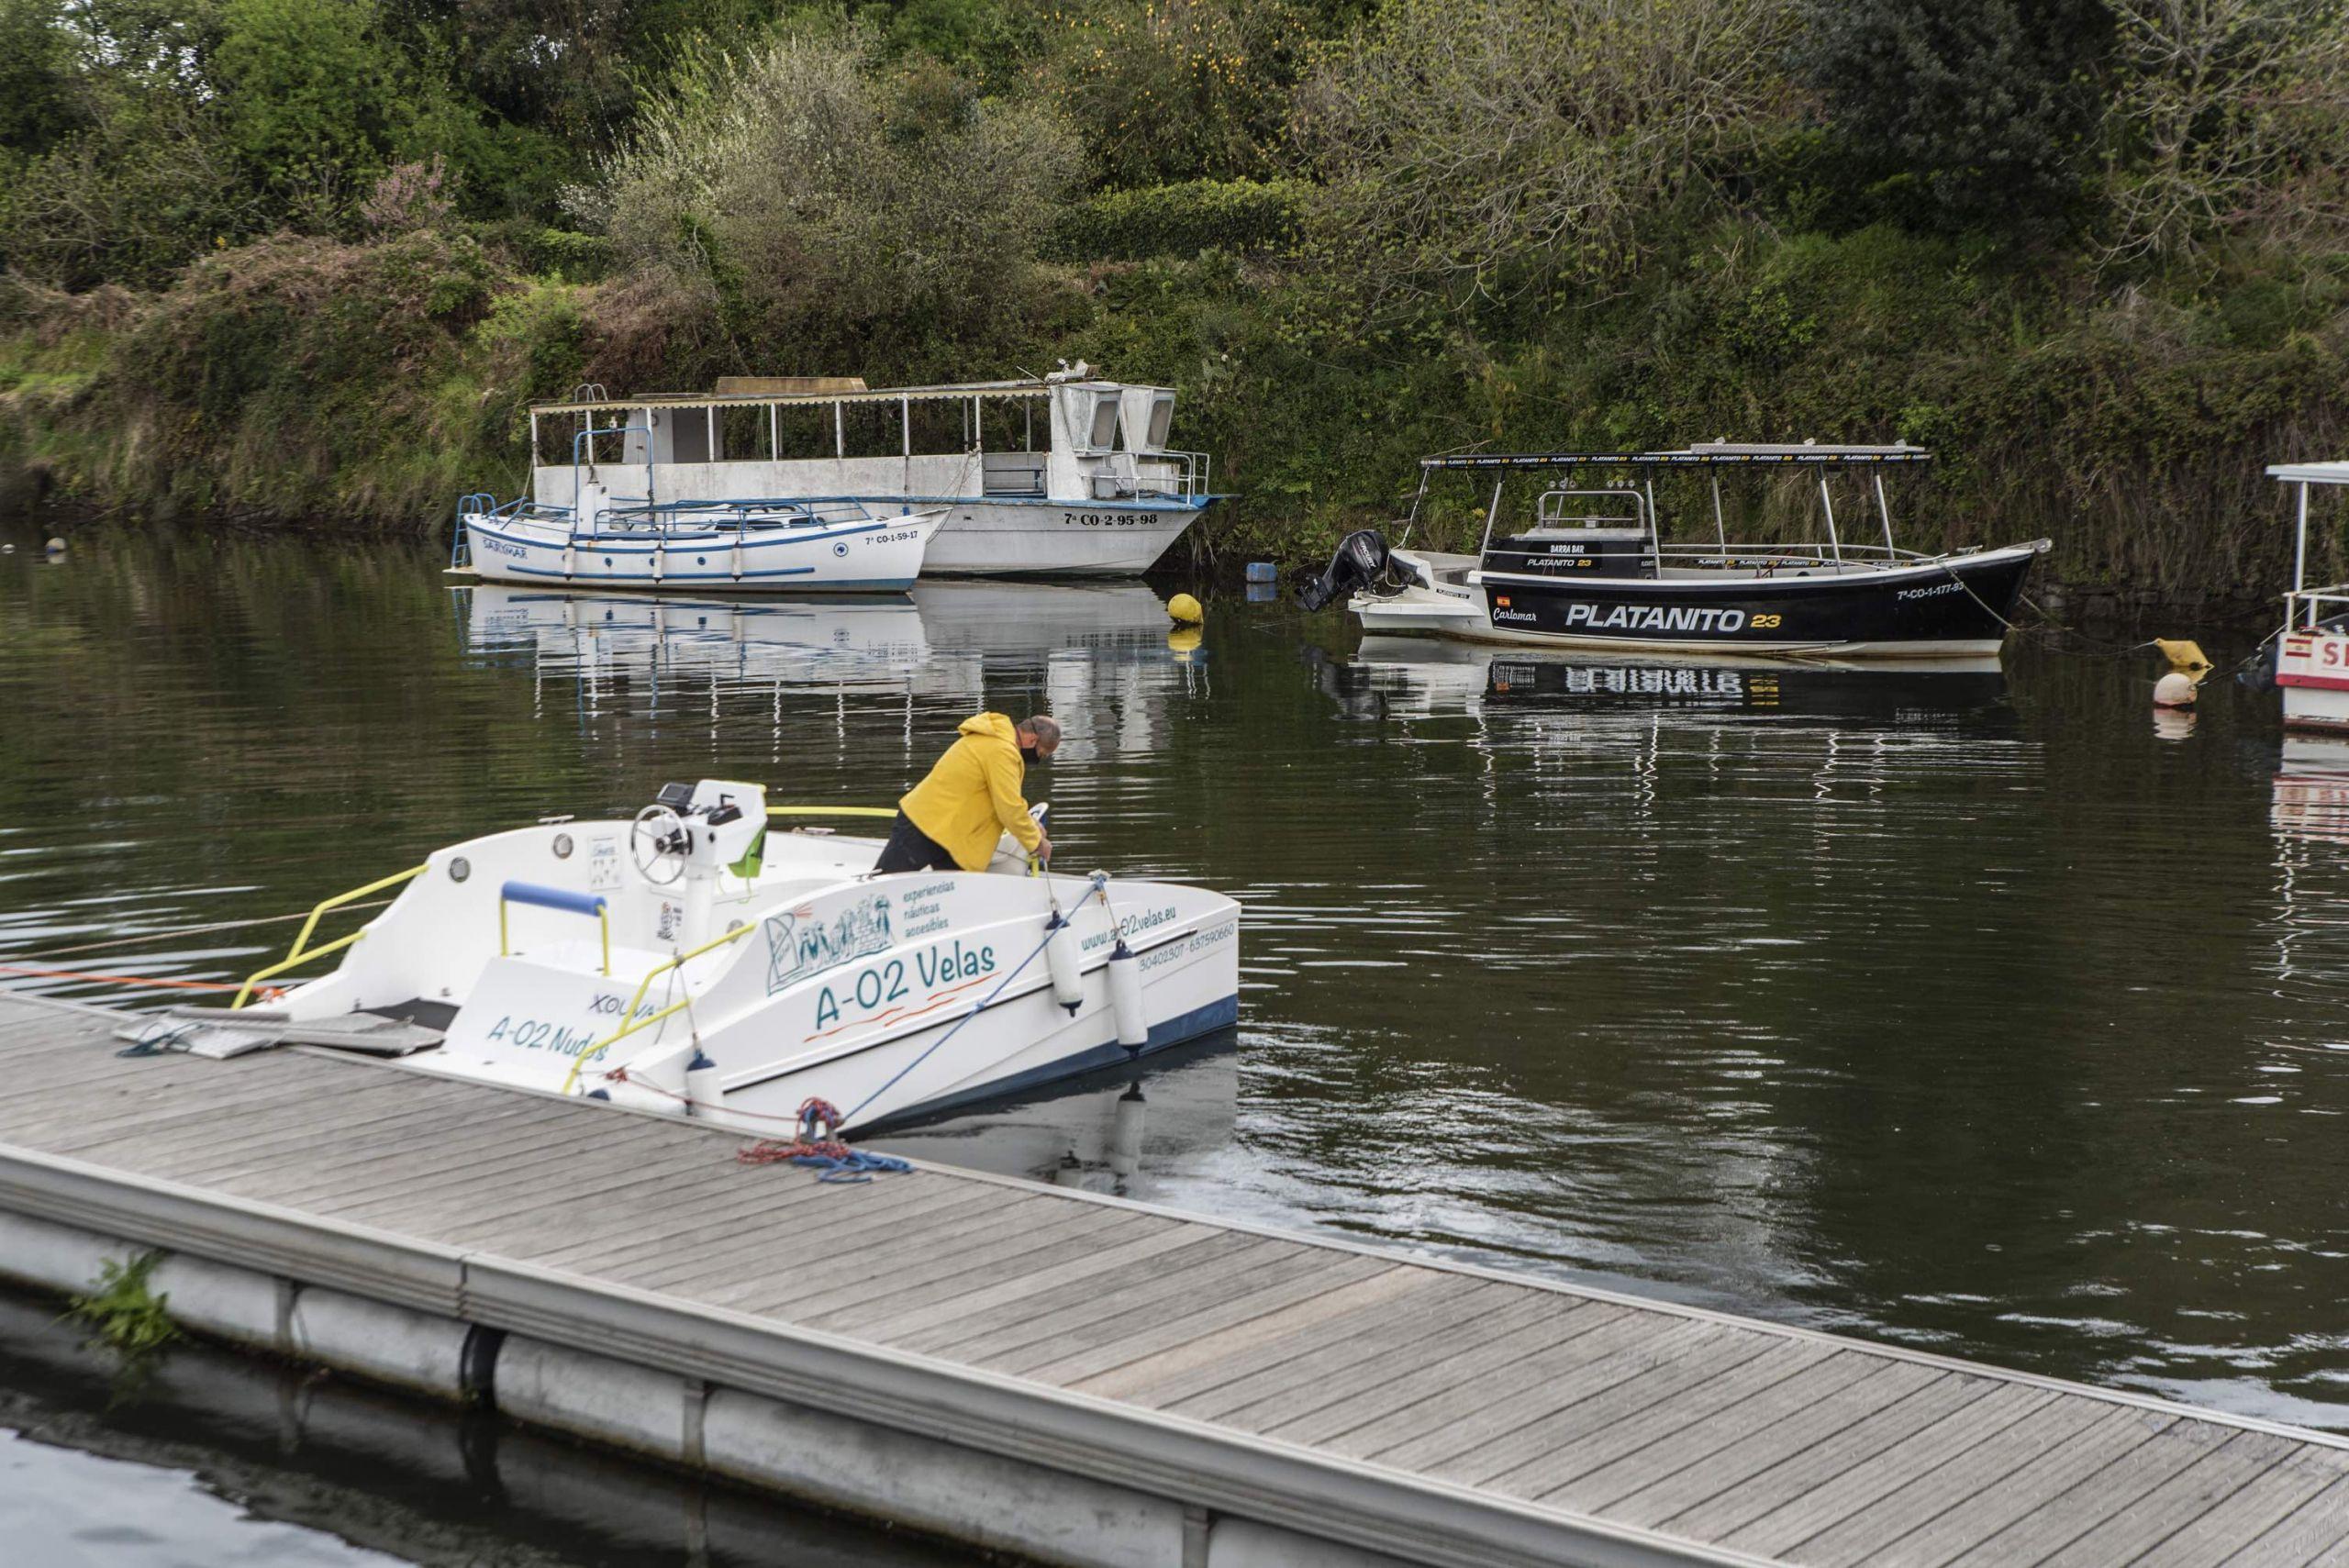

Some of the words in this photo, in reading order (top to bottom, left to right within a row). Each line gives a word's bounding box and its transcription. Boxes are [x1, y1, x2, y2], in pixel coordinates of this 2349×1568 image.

[1527, 559, 1575, 567] PLATANITO
[1493, 607, 1537, 622] Carlomar
[1565, 604, 1745, 632] PLATANITO
[1750, 614, 1782, 628] 23
[2322, 641, 2349, 668] S
[903, 881, 955, 904] experiencias
[905, 917, 950, 938] accesibles
[917, 940, 996, 988] Velas
